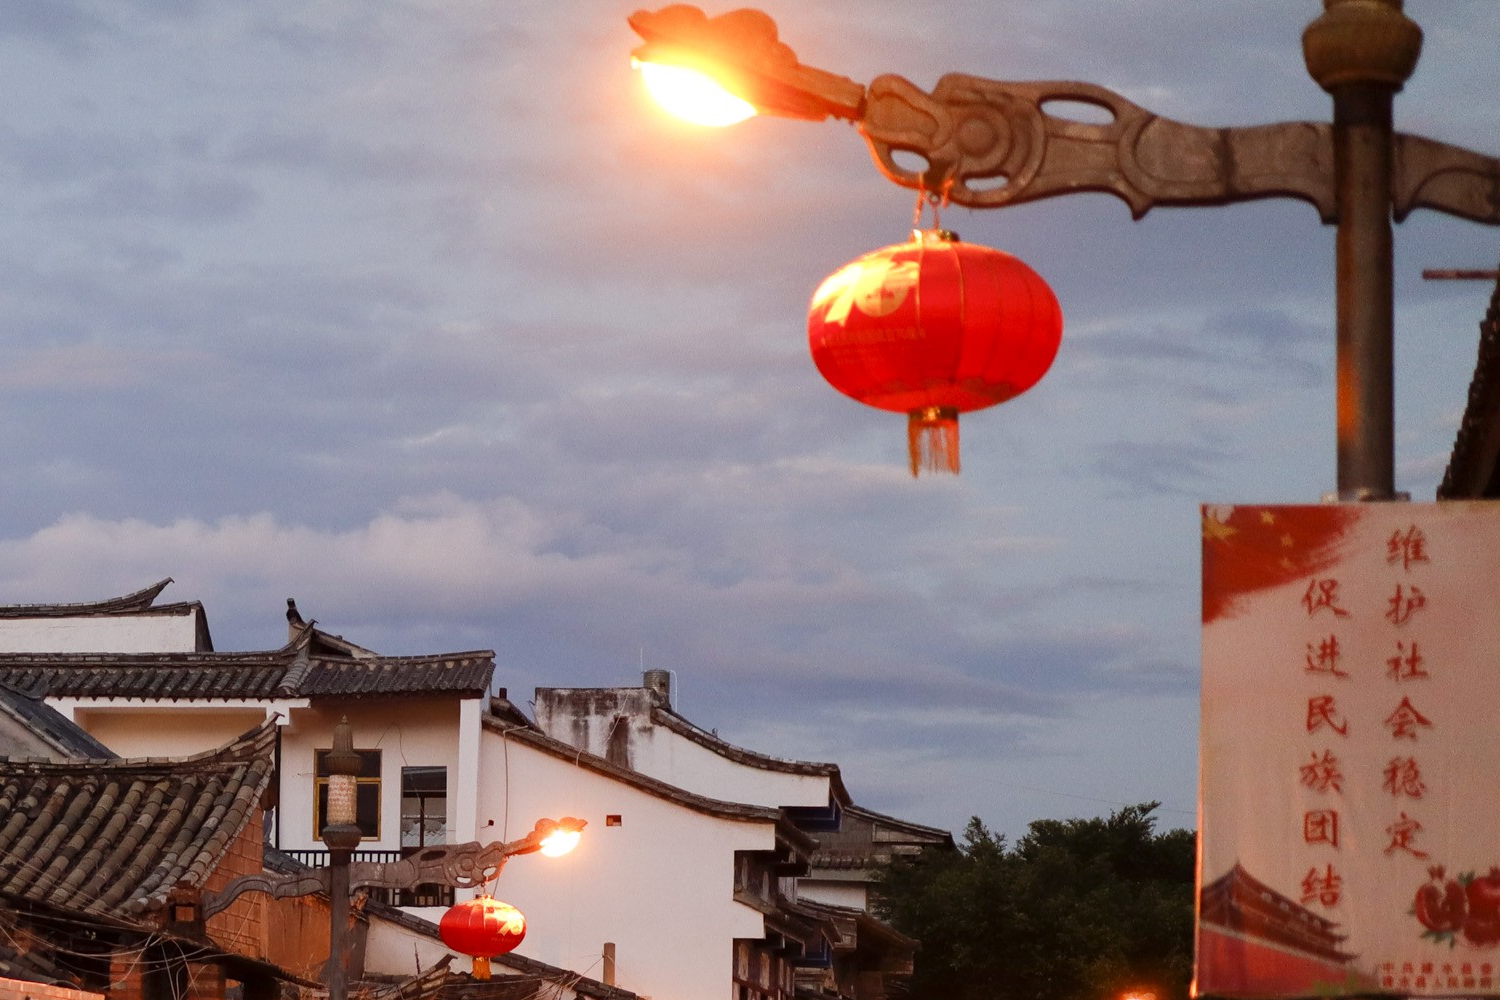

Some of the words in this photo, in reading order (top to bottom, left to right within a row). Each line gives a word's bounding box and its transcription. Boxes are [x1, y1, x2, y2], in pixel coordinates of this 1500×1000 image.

[1300, 578, 1350, 909] 促进民族团结
[1384, 525, 1432, 860] 维护社会稳定
